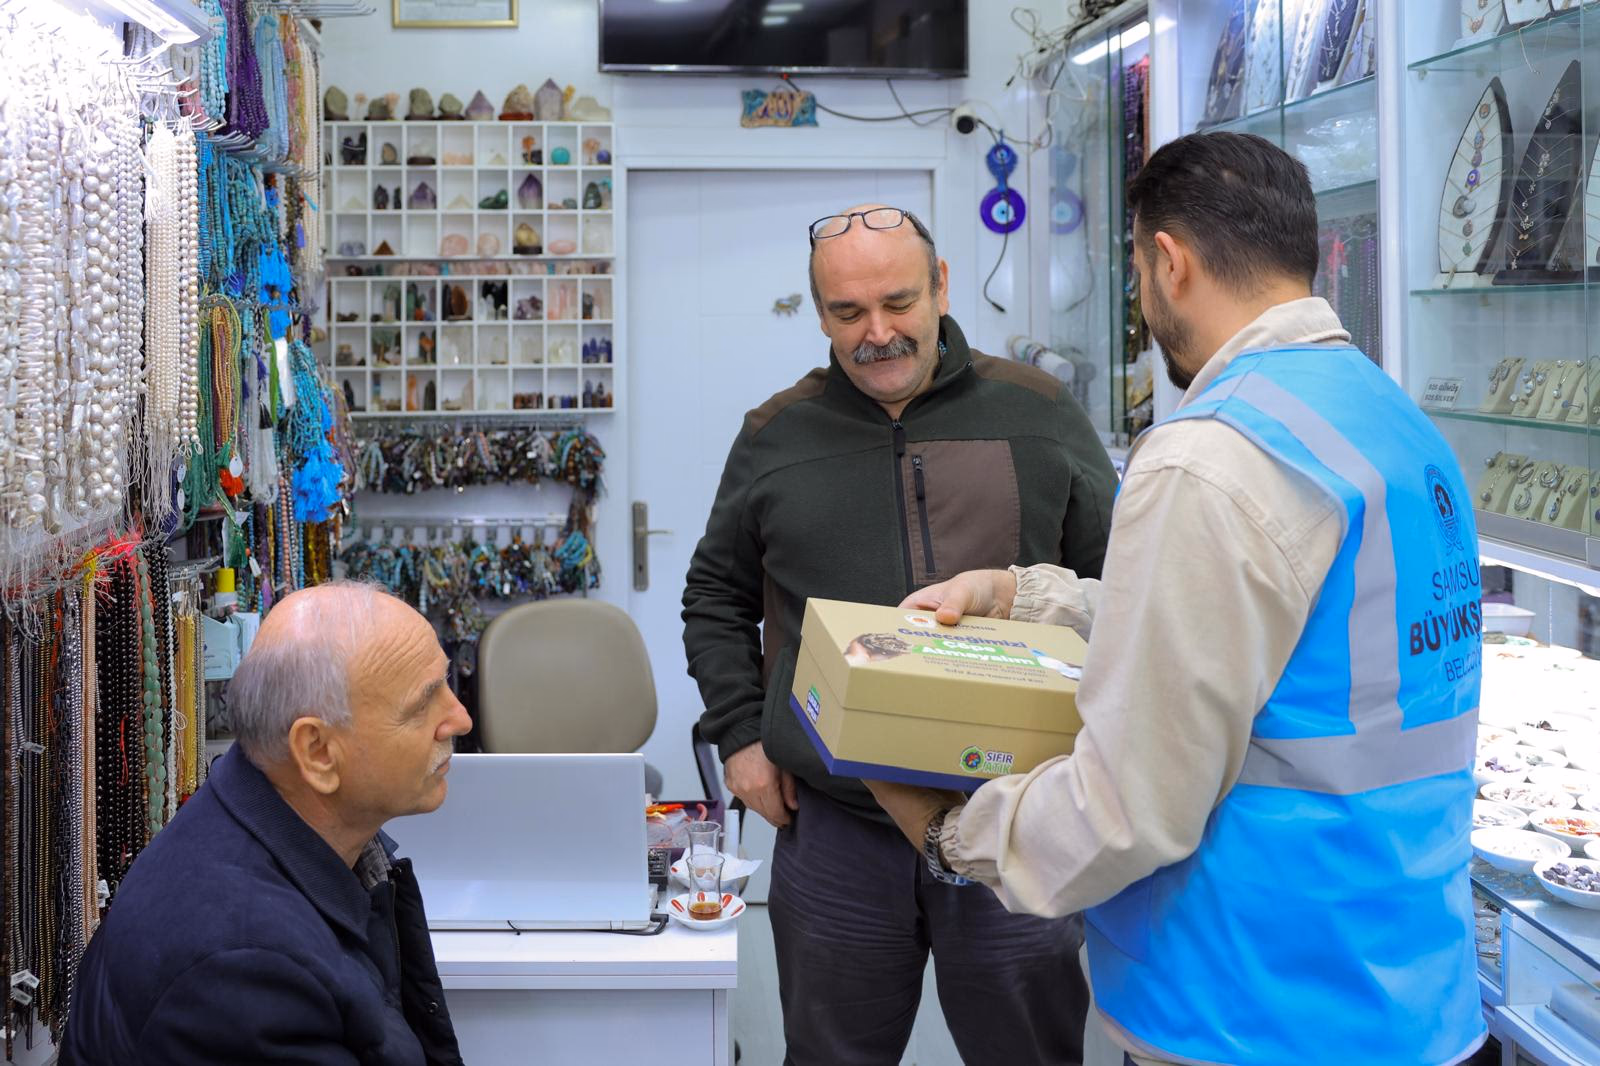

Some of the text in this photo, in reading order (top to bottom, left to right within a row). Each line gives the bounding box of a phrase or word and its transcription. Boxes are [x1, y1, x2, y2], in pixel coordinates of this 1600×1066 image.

[1432, 557, 1480, 601] SAMSU
[1410, 599, 1482, 656] BÜYÜKŞ
[986, 751, 1013, 764] SIFIR
